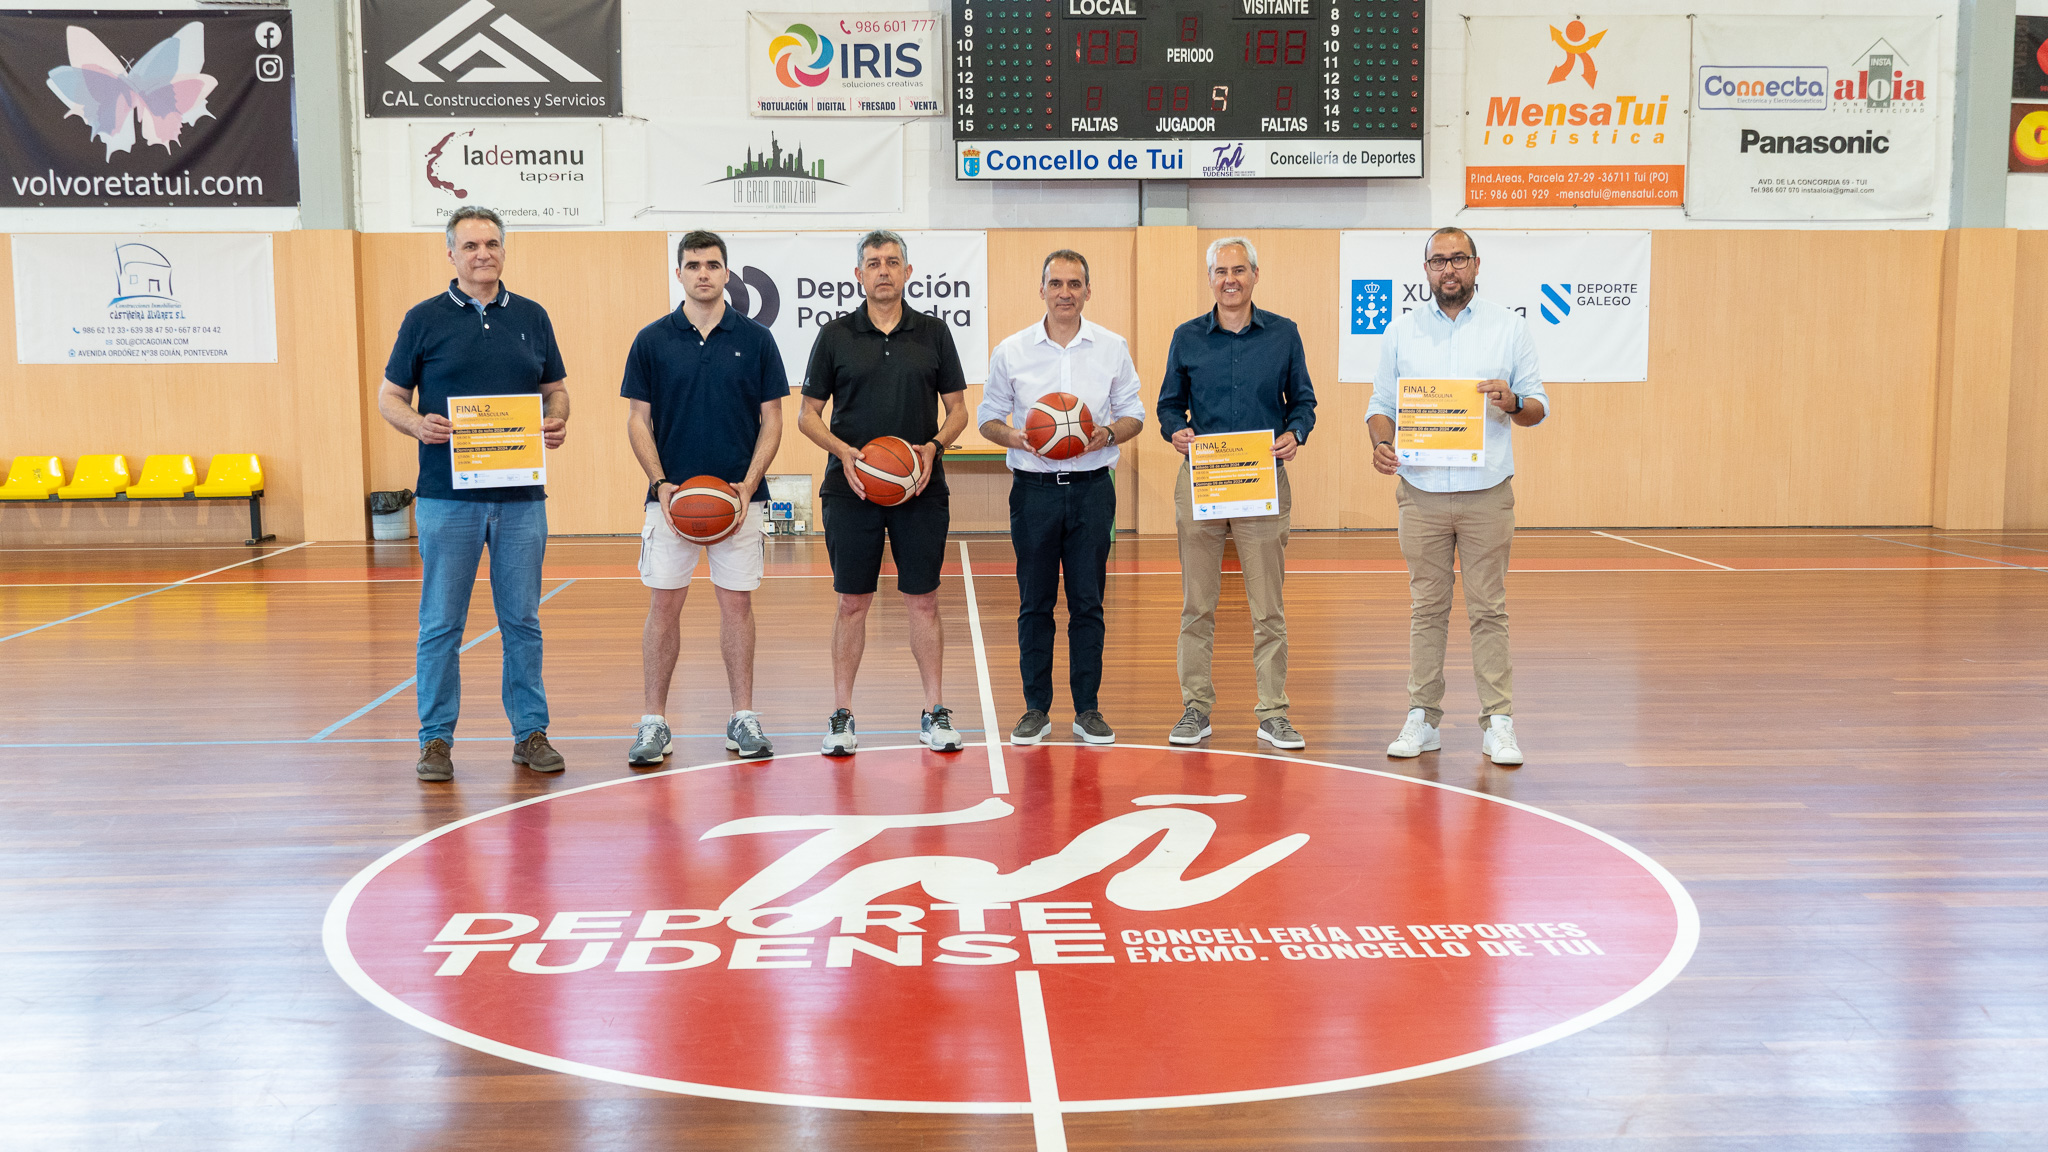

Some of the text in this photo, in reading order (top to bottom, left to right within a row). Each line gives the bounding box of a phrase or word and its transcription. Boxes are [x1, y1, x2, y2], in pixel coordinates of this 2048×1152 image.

[1069, 0, 1136, 15] LOCAL
[1244, 0, 1309, 15] VISITANTE
[964, 8, 974, 20] 8
[1331, 8, 1340, 20] 8
[856, 19, 936, 32] 986 601 777
[964, 25, 974, 37] 9
[1331, 24, 1340, 36] 9
[957, 40, 974, 52] 10
[1324, 40, 1340, 52] 10
[840, 42, 922, 78] IRIS
[1166, 48, 1214, 63] PERIODO
[957, 56, 974, 68] 11
[1324, 56, 1340, 68] 11
[1870, 58, 1892, 66] INSTA
[842, 80, 924, 88] soluciones creativas
[957, 72, 974, 84] 12
[1324, 72, 1340, 84] 12
[1704, 76, 1824, 96] Connecta
[1834, 70, 1926, 101] aloia
[382, 91, 606, 108] CAL Construcciones y Servicios
[957, 88, 974, 100] 13
[1324, 88, 1340, 100] 13
[761, 100, 808, 111] ROTULACIÓN
[816, 102, 846, 111] DIGITAL
[861, 102, 896, 110] FRESADO
[914, 101, 938, 110] VENTA
[957, 104, 974, 116] 14
[1324, 104, 1340, 116] 14
[1485, 95, 1670, 127] MensaTui
[957, 120, 974, 132] 15
[1072, 118, 1118, 132] FALTAS
[1156, 118, 1216, 132] JUGADOR
[1262, 118, 1308, 132] FALTAS
[1324, 120, 1340, 132] 15
[1484, 130, 1665, 148] logistica
[1740, 130, 1890, 154] Panasonic
[464, 144, 584, 166] lademanu
[986, 148, 1184, 170] Concello de Tui
[1270, 150, 1416, 167] Concellería de Deportes
[12, 168, 264, 196] volvoretatui.com
[1470, 172, 1669, 184] P.Ind.Areas, Parcela 27-29 -36711 Tui (PO)
[733, 180, 743, 203] LA
[1471, 188, 1678, 200] TLF: 986 601 929 -mensatui@mensatui.com
[1801, 187, 1874, 195] instaaloia@gmail.com
[542, 208, 554, 216] 40
[563, 208, 580, 216] TUI
[1577, 284, 1638, 294] DEPORTE
[1577, 296, 1632, 306] GALEGO
[156, 326, 164, 334] 47
[165, 326, 174, 334] 50
[192, 326, 201, 334] 87
[202, 326, 210, 334] 04
[212, 326, 221, 334] 42
[116, 338, 189, 346] SOL@CICAGOIAN.COM
[108, 348, 140, 356] ORDÓÑEZ
[159, 349, 182, 358] GOIÁN,
[1403, 386, 1436, 394] FINAL 2
[485, 404, 490, 412] 2
[1196, 442, 1219, 450] FINAL
[434, 901, 1101, 938] DEPORTE
[1120, 922, 1588, 945] CONCELLERÍA DE DEPORTES
[423, 932, 1115, 977] TUDENSE
[1126, 939, 1607, 963] EXCMO. CONCELLO DE TUI
